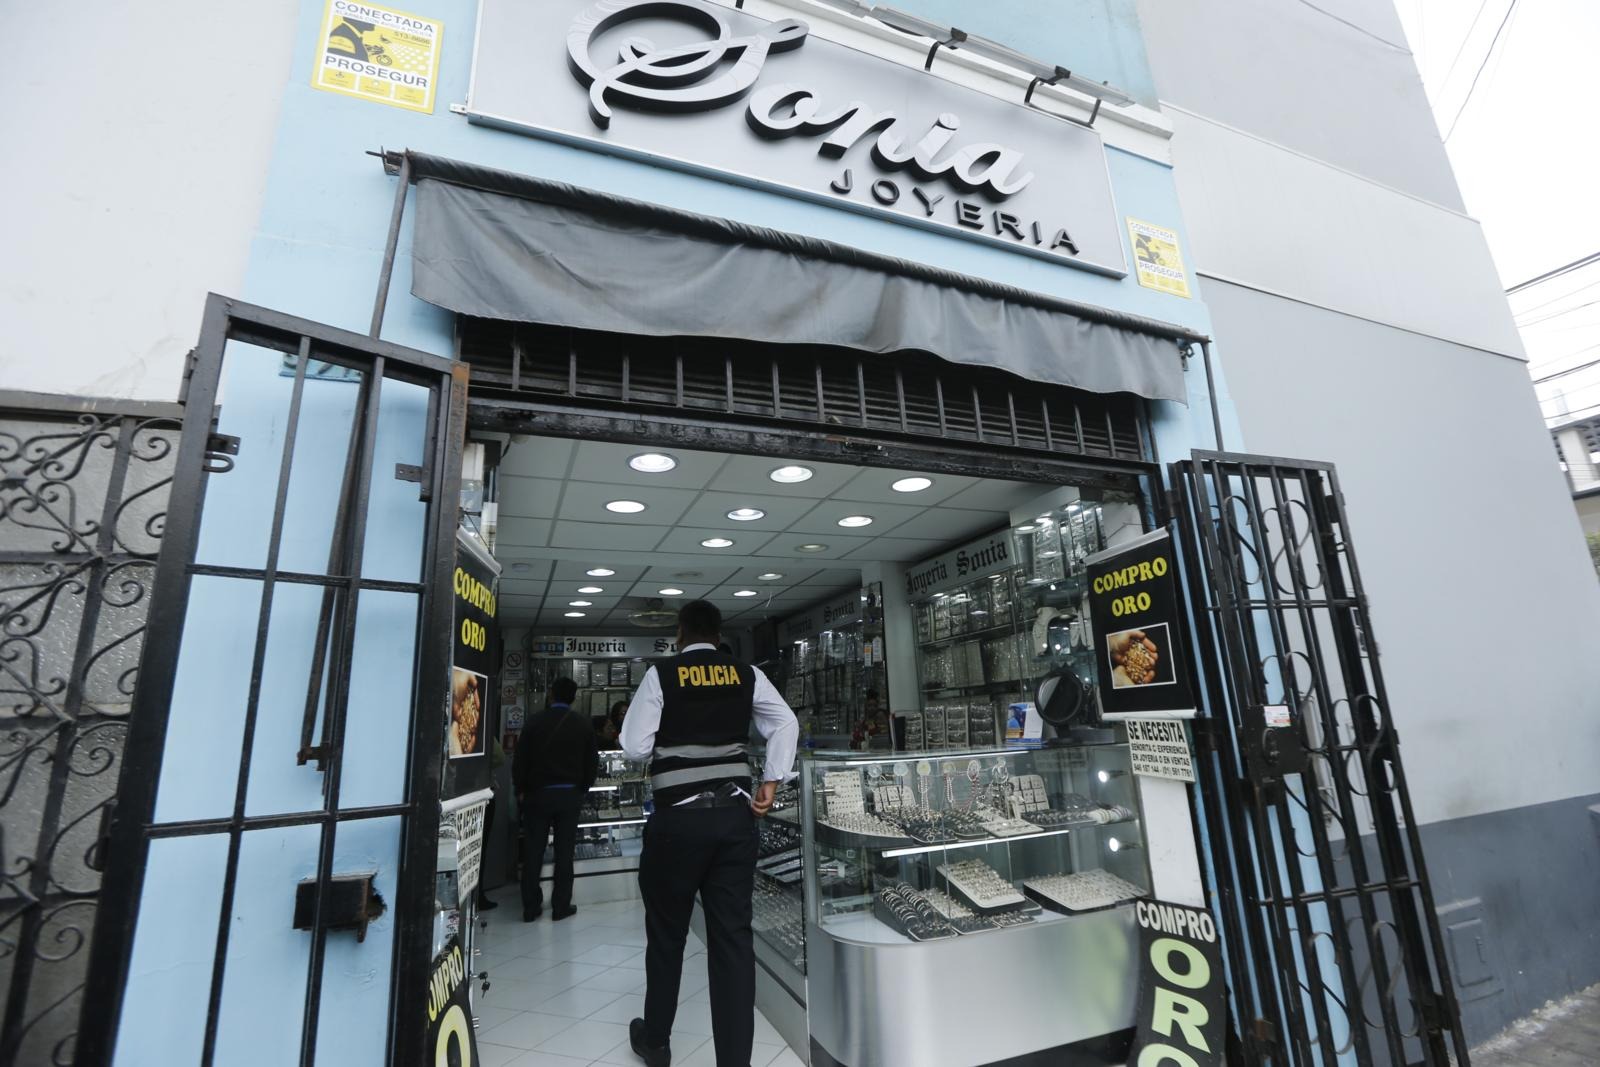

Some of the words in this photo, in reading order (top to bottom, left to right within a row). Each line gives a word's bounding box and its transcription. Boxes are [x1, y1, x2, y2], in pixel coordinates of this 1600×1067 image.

[335, 1, 434, 33] CONECTADA
[325, 55, 428, 88] PROSEGUR
[566, 1, 1034, 204] Sonia
[829, 168, 1080, 255] JOYERIA
[454, 567, 496, 618] COMPRO
[1093, 557, 1167, 594] COMPRO
[1111, 592, 1151, 617] ORO
[461, 618, 486, 652] ORO
[566, 637, 627, 655] Joyeria
[1128, 721, 1140, 740] SE
[1140, 721, 1185, 743] NECESITA
[1136, 900, 1216, 943] COMPRO
